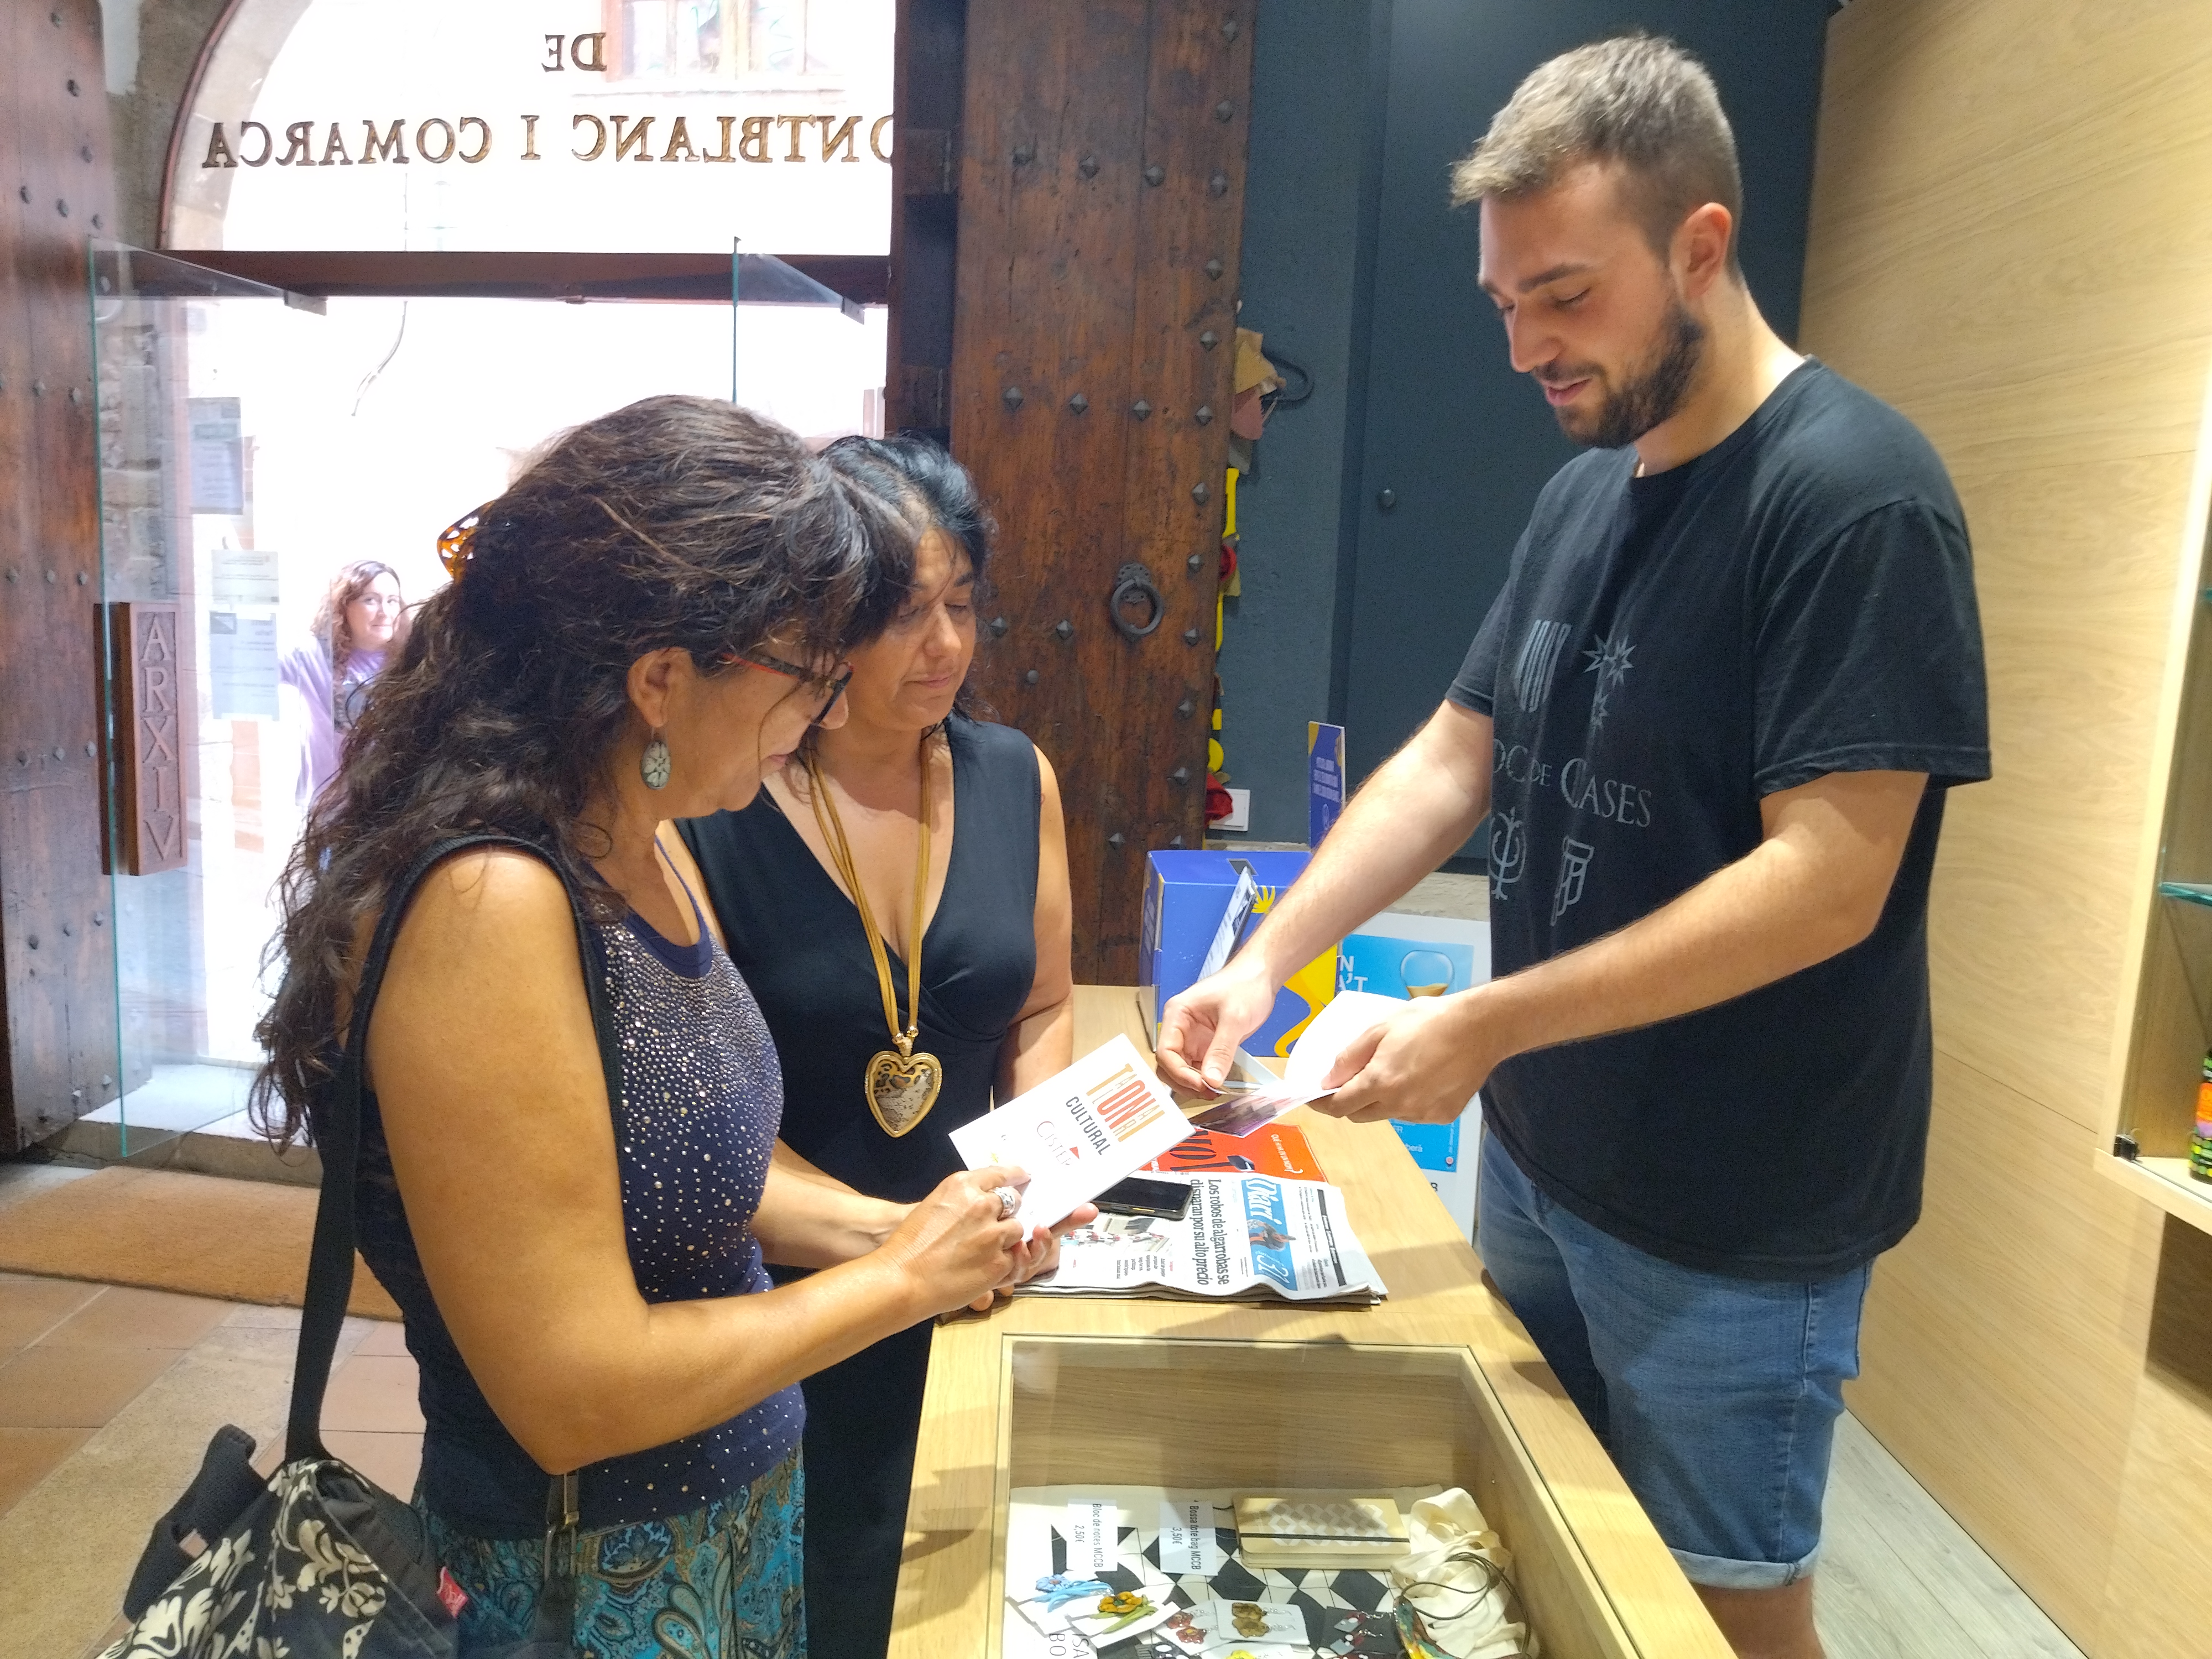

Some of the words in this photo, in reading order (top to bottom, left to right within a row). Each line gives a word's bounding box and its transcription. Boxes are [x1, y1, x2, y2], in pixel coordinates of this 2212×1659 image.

[1561, 758, 1652, 828] CASES
[1066, 1095, 1111, 1156] CULTURAL
[1208, 1179, 1222, 1195] Los
[1210, 1196, 1224, 1218] robos
[1245, 1180, 1282, 1225] Diari
[1190, 1217, 1204, 1231] por
[1212, 1218, 1226, 1229] de
[1193, 1232, 1205, 1241] su
[1194, 1242, 1209, 1258] alto
[1210, 1229, 1231, 1274] algarrobas
[1192, 1258, 1213, 1285] precio
[1218, 1275, 1230, 1285] se
[1092, 1503, 1102, 1517] Bloc
[1190, 1505, 1199, 1523] Bossa
[1093, 1519, 1103, 1527] de
[1190, 1525, 1200, 1536] tote
[1073, 1525, 1084, 1542] 2,50€
[1093, 1528, 1102, 1545] notes
[1172, 1527, 1182, 1545] 3,50€
[1188, 1538, 1200, 1549] bag
[1094, 1548, 1103, 1567] MCCB
[1191, 1551, 1201, 1570] MCCB
